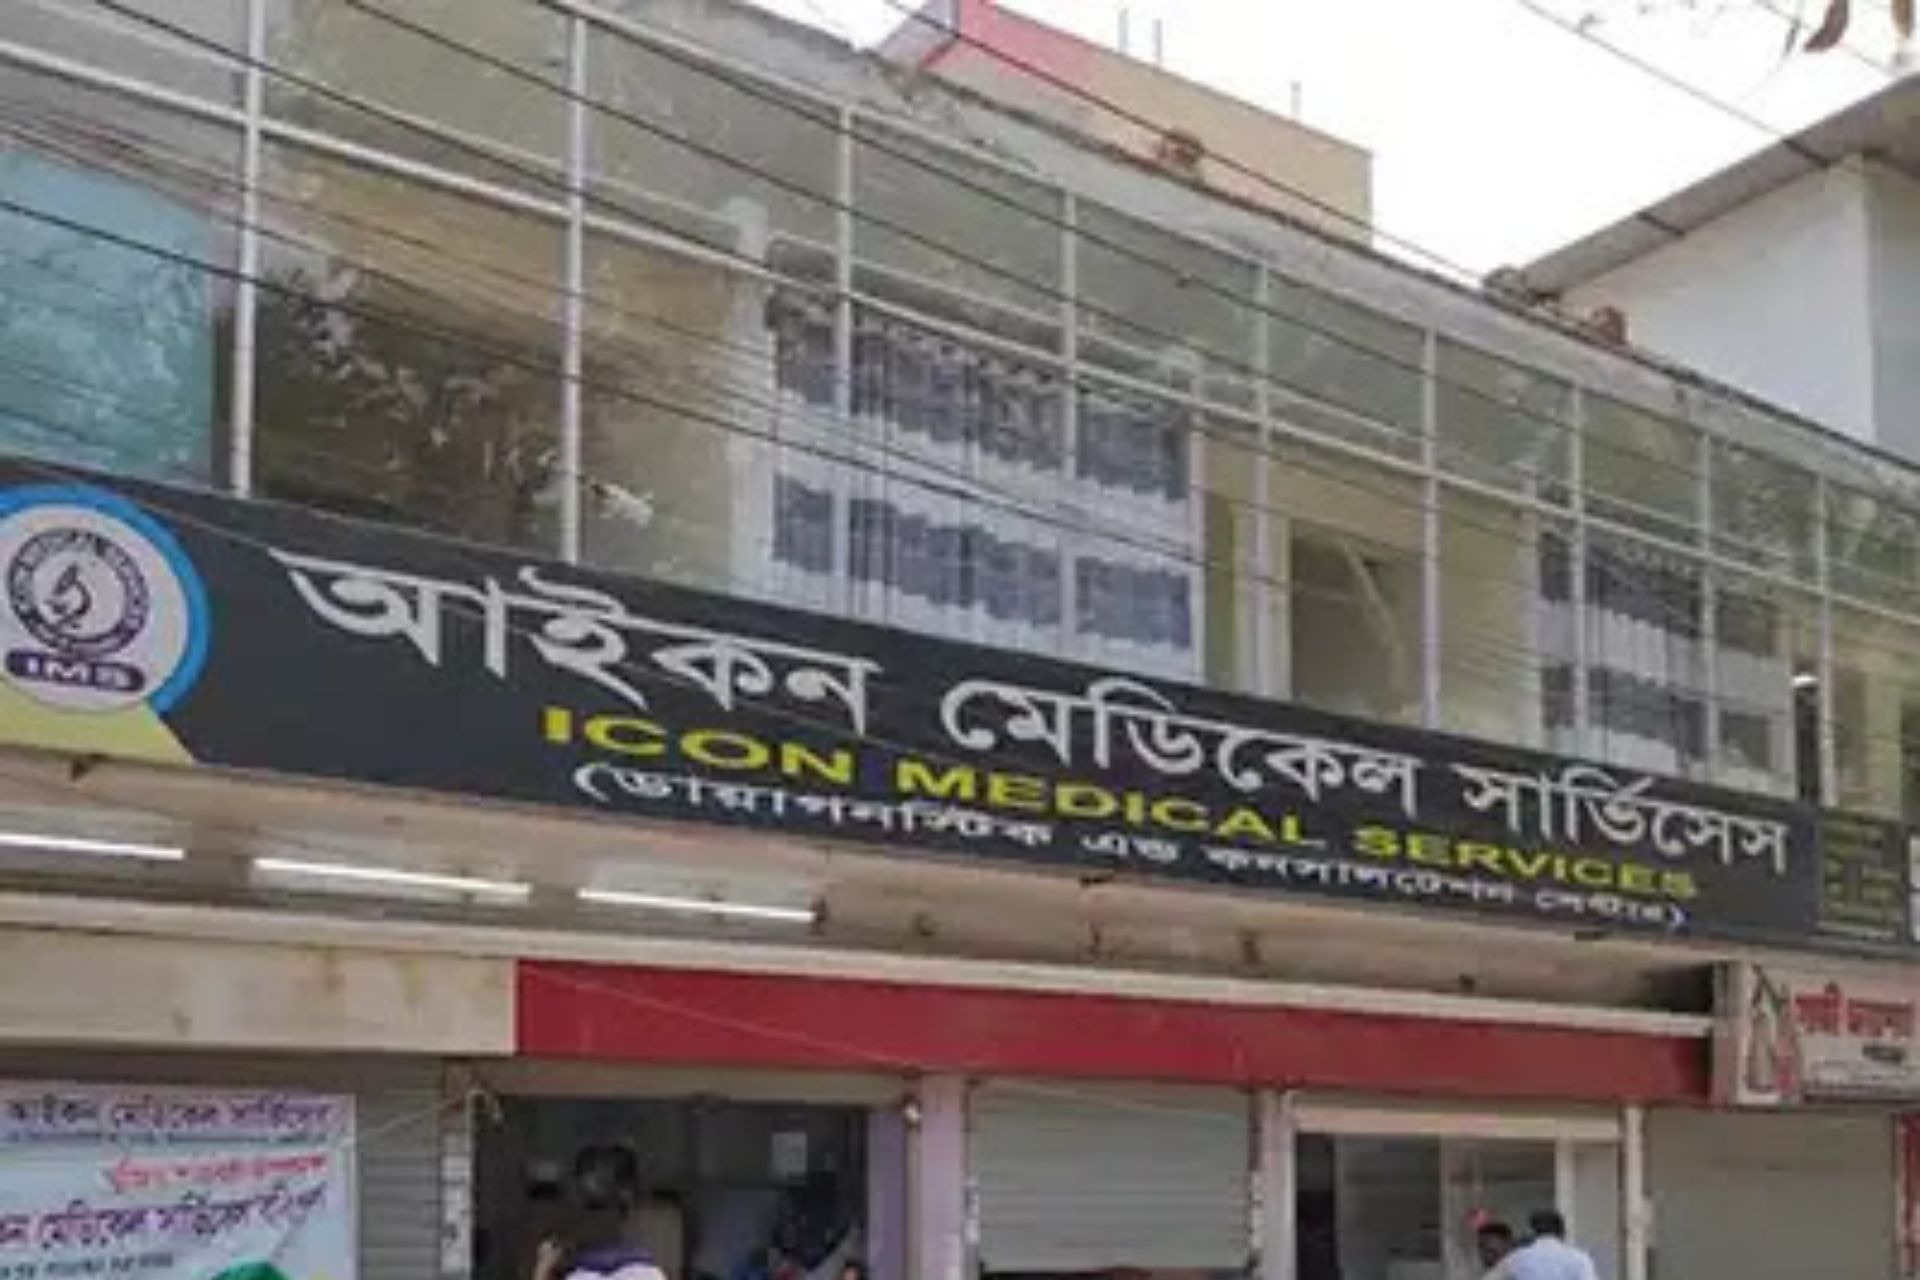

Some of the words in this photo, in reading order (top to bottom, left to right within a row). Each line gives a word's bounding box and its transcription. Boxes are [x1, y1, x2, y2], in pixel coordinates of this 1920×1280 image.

[268, 547, 881, 736] আইকন
[941, 679, 1421, 818] মেডিকেল
[1455, 763, 1788, 875] সার্ভিসেস
[546, 707, 852, 783] ICON
[897, 760, 1326, 844] MEDICAL
[1353, 825, 1695, 898] SERVICES
